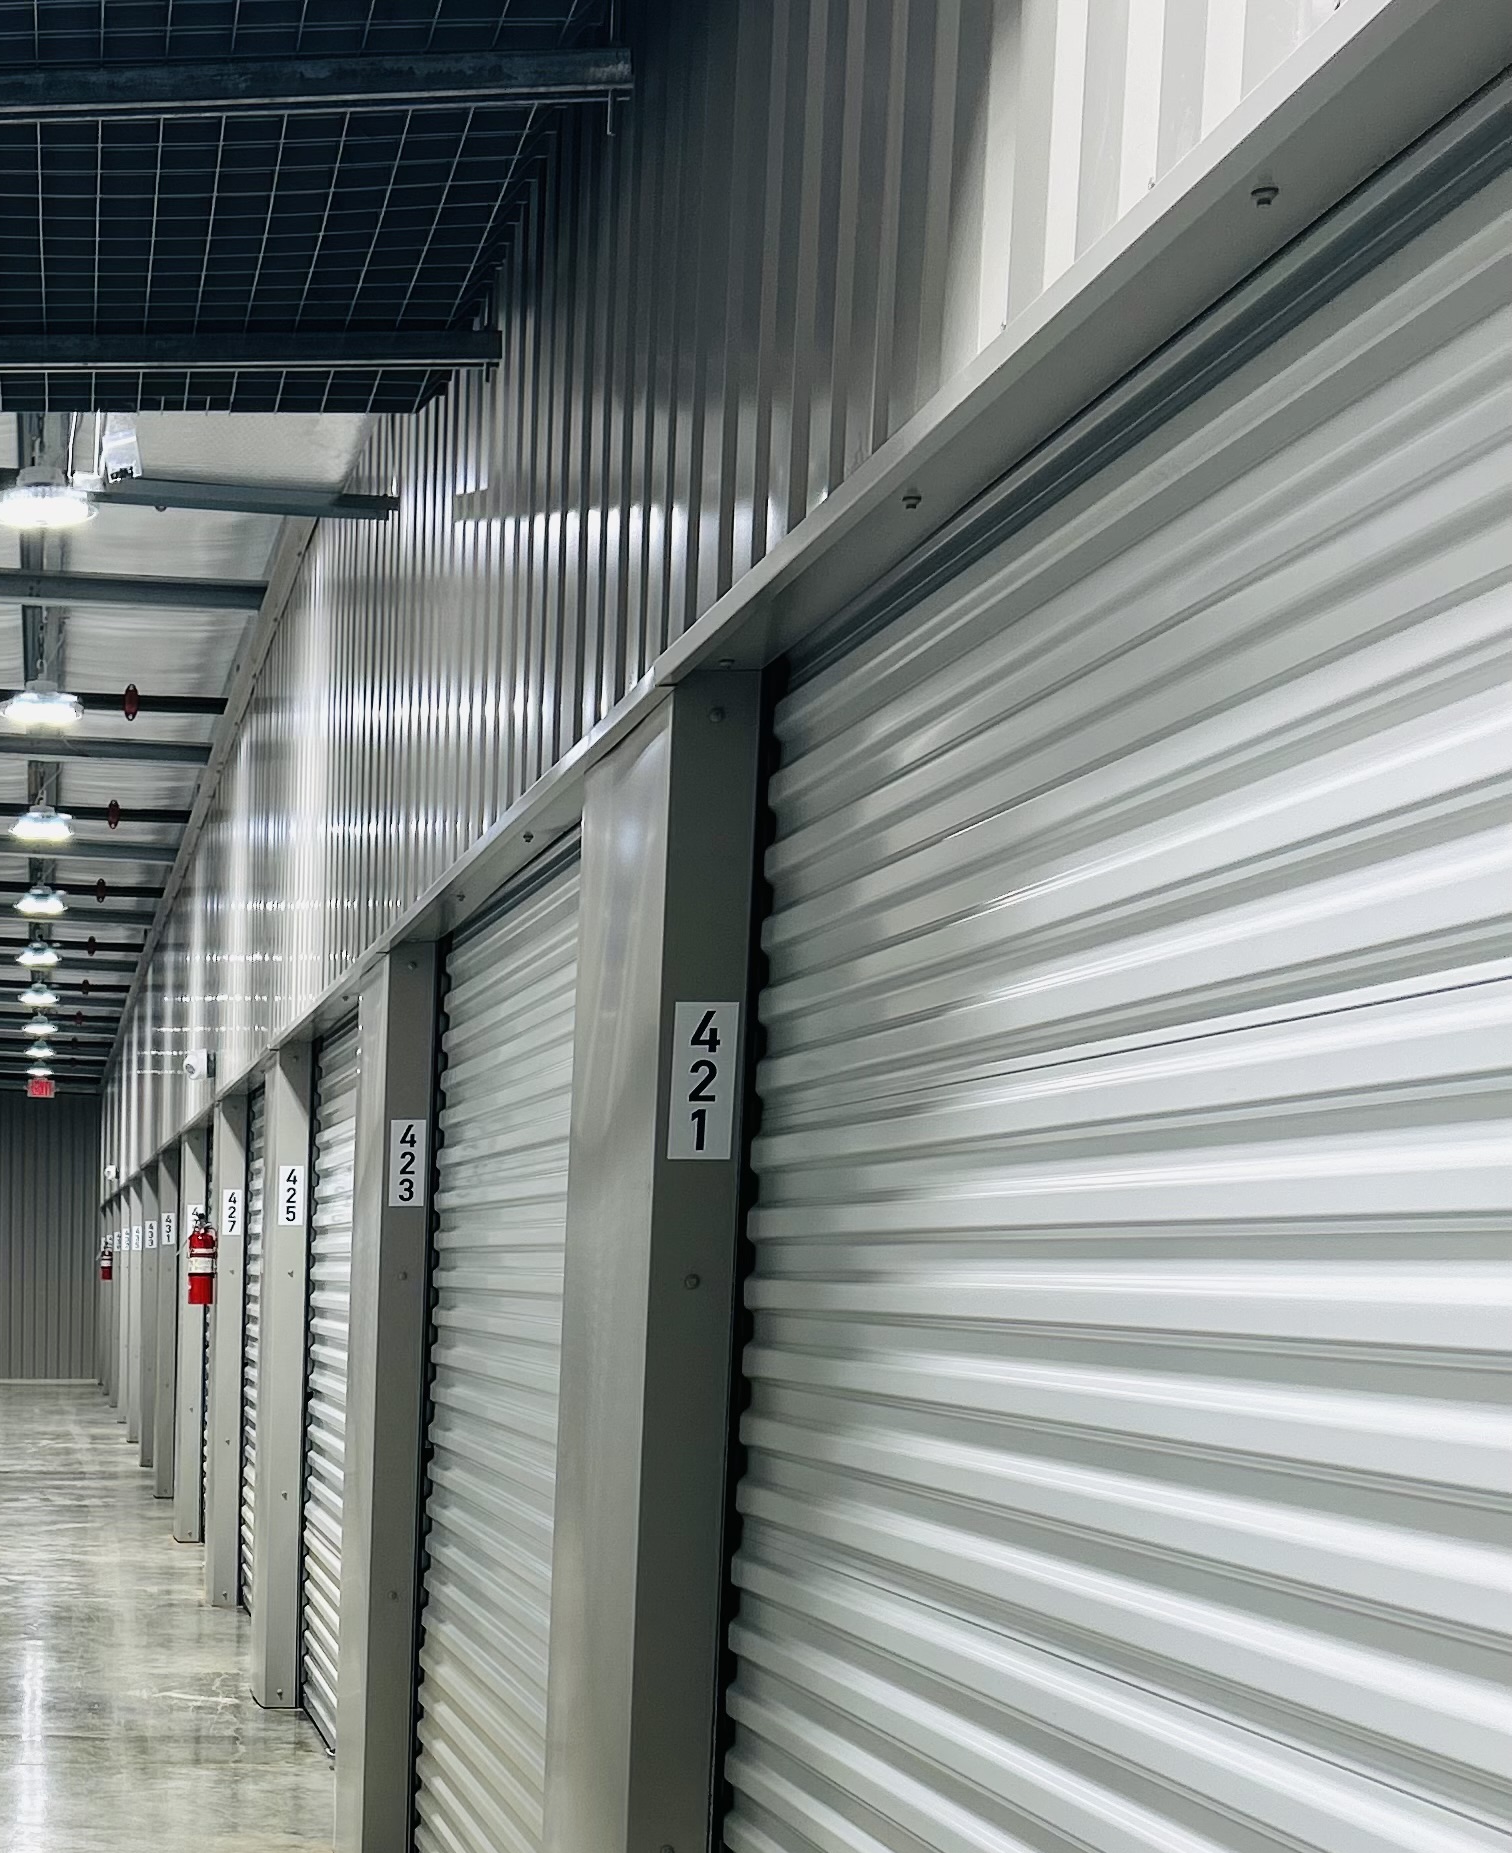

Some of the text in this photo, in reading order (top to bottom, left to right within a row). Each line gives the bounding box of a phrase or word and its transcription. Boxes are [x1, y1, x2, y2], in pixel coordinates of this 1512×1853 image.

[689, 1009, 722, 1152] 421
[285, 1167, 298, 1223] 425
[398, 1122, 417, 1203] 423
[228, 1191, 237, 1233] 427
